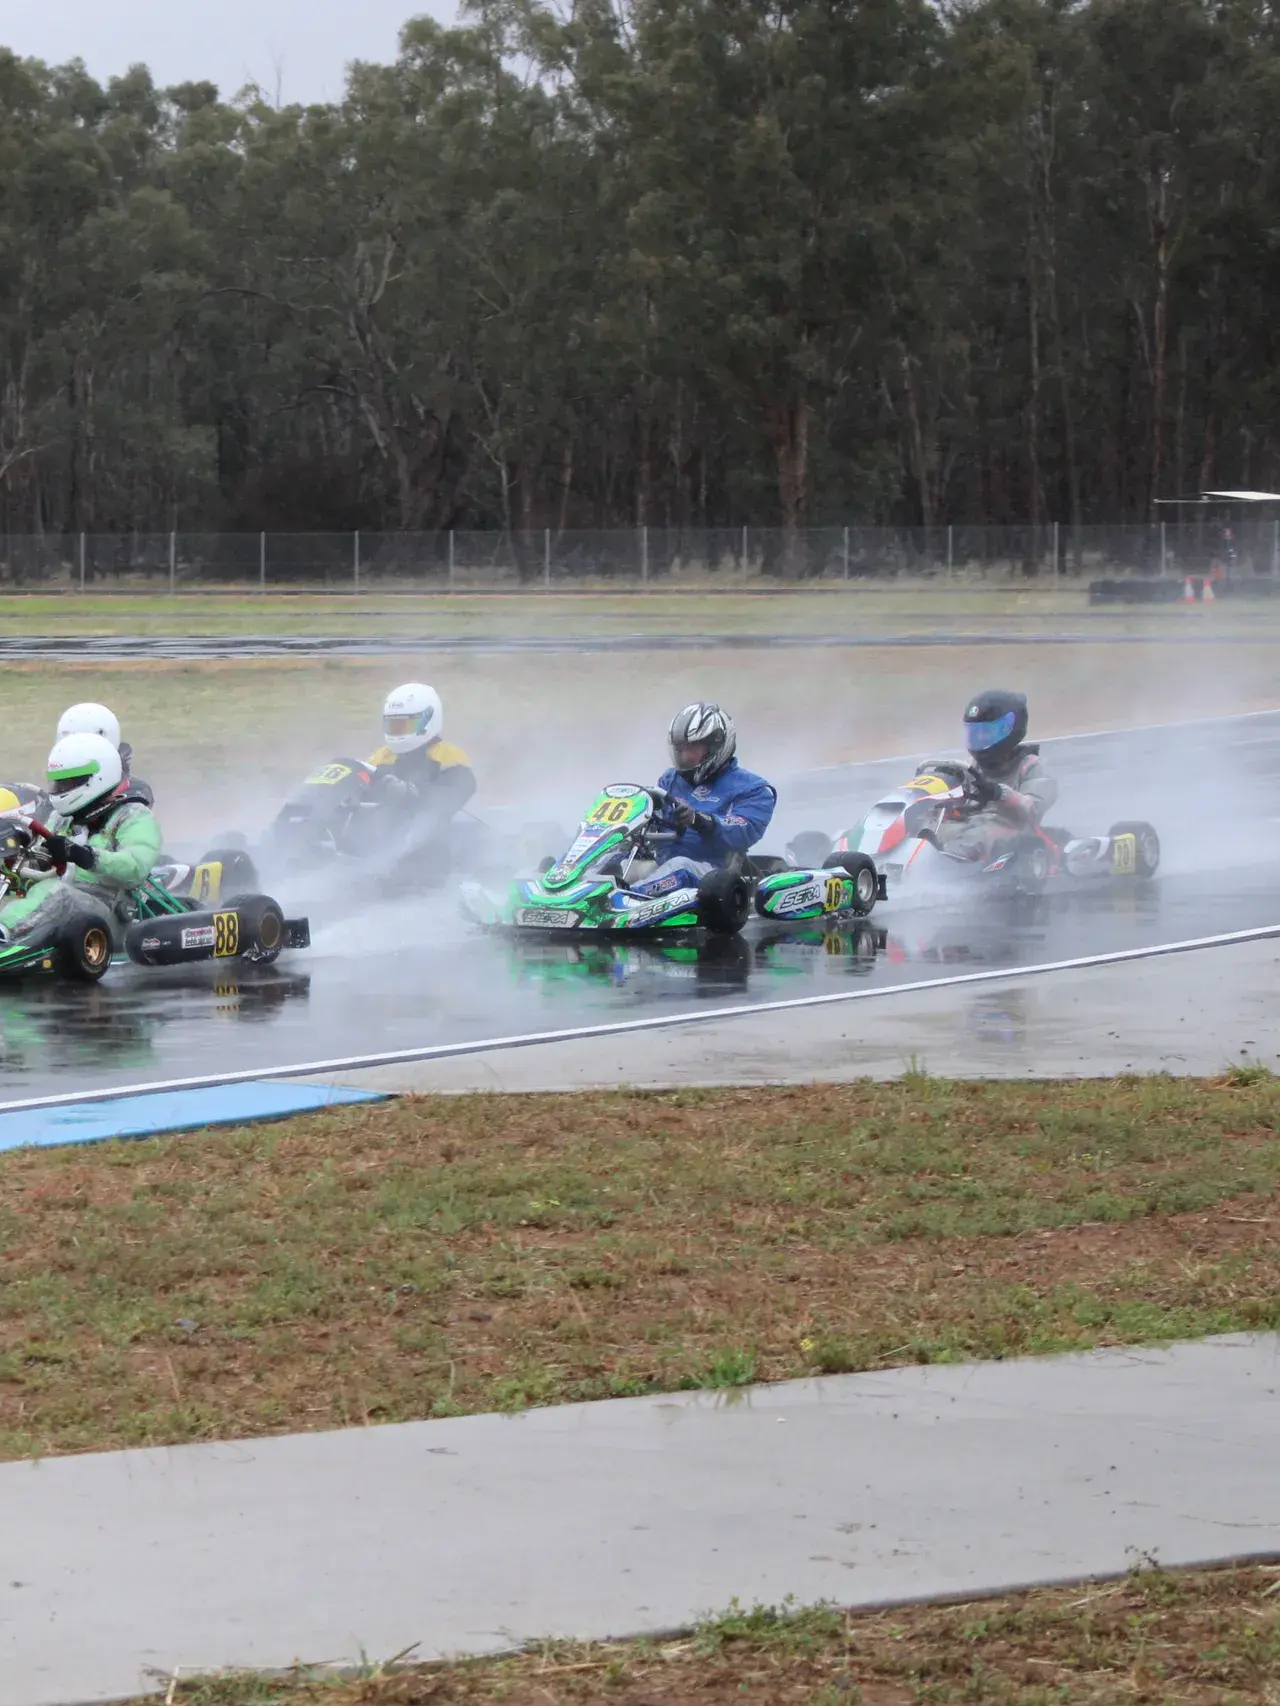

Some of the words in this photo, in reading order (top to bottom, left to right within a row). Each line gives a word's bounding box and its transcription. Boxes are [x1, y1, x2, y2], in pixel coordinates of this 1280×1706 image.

[592, 801, 628, 822] 46
[201, 868, 211, 900] 6
[780, 884, 821, 910] SERA
[826, 881, 841, 909] 46
[523, 911, 569, 925] SERA
[638, 892, 691, 920] SERA
[215, 915, 237, 955] 88
